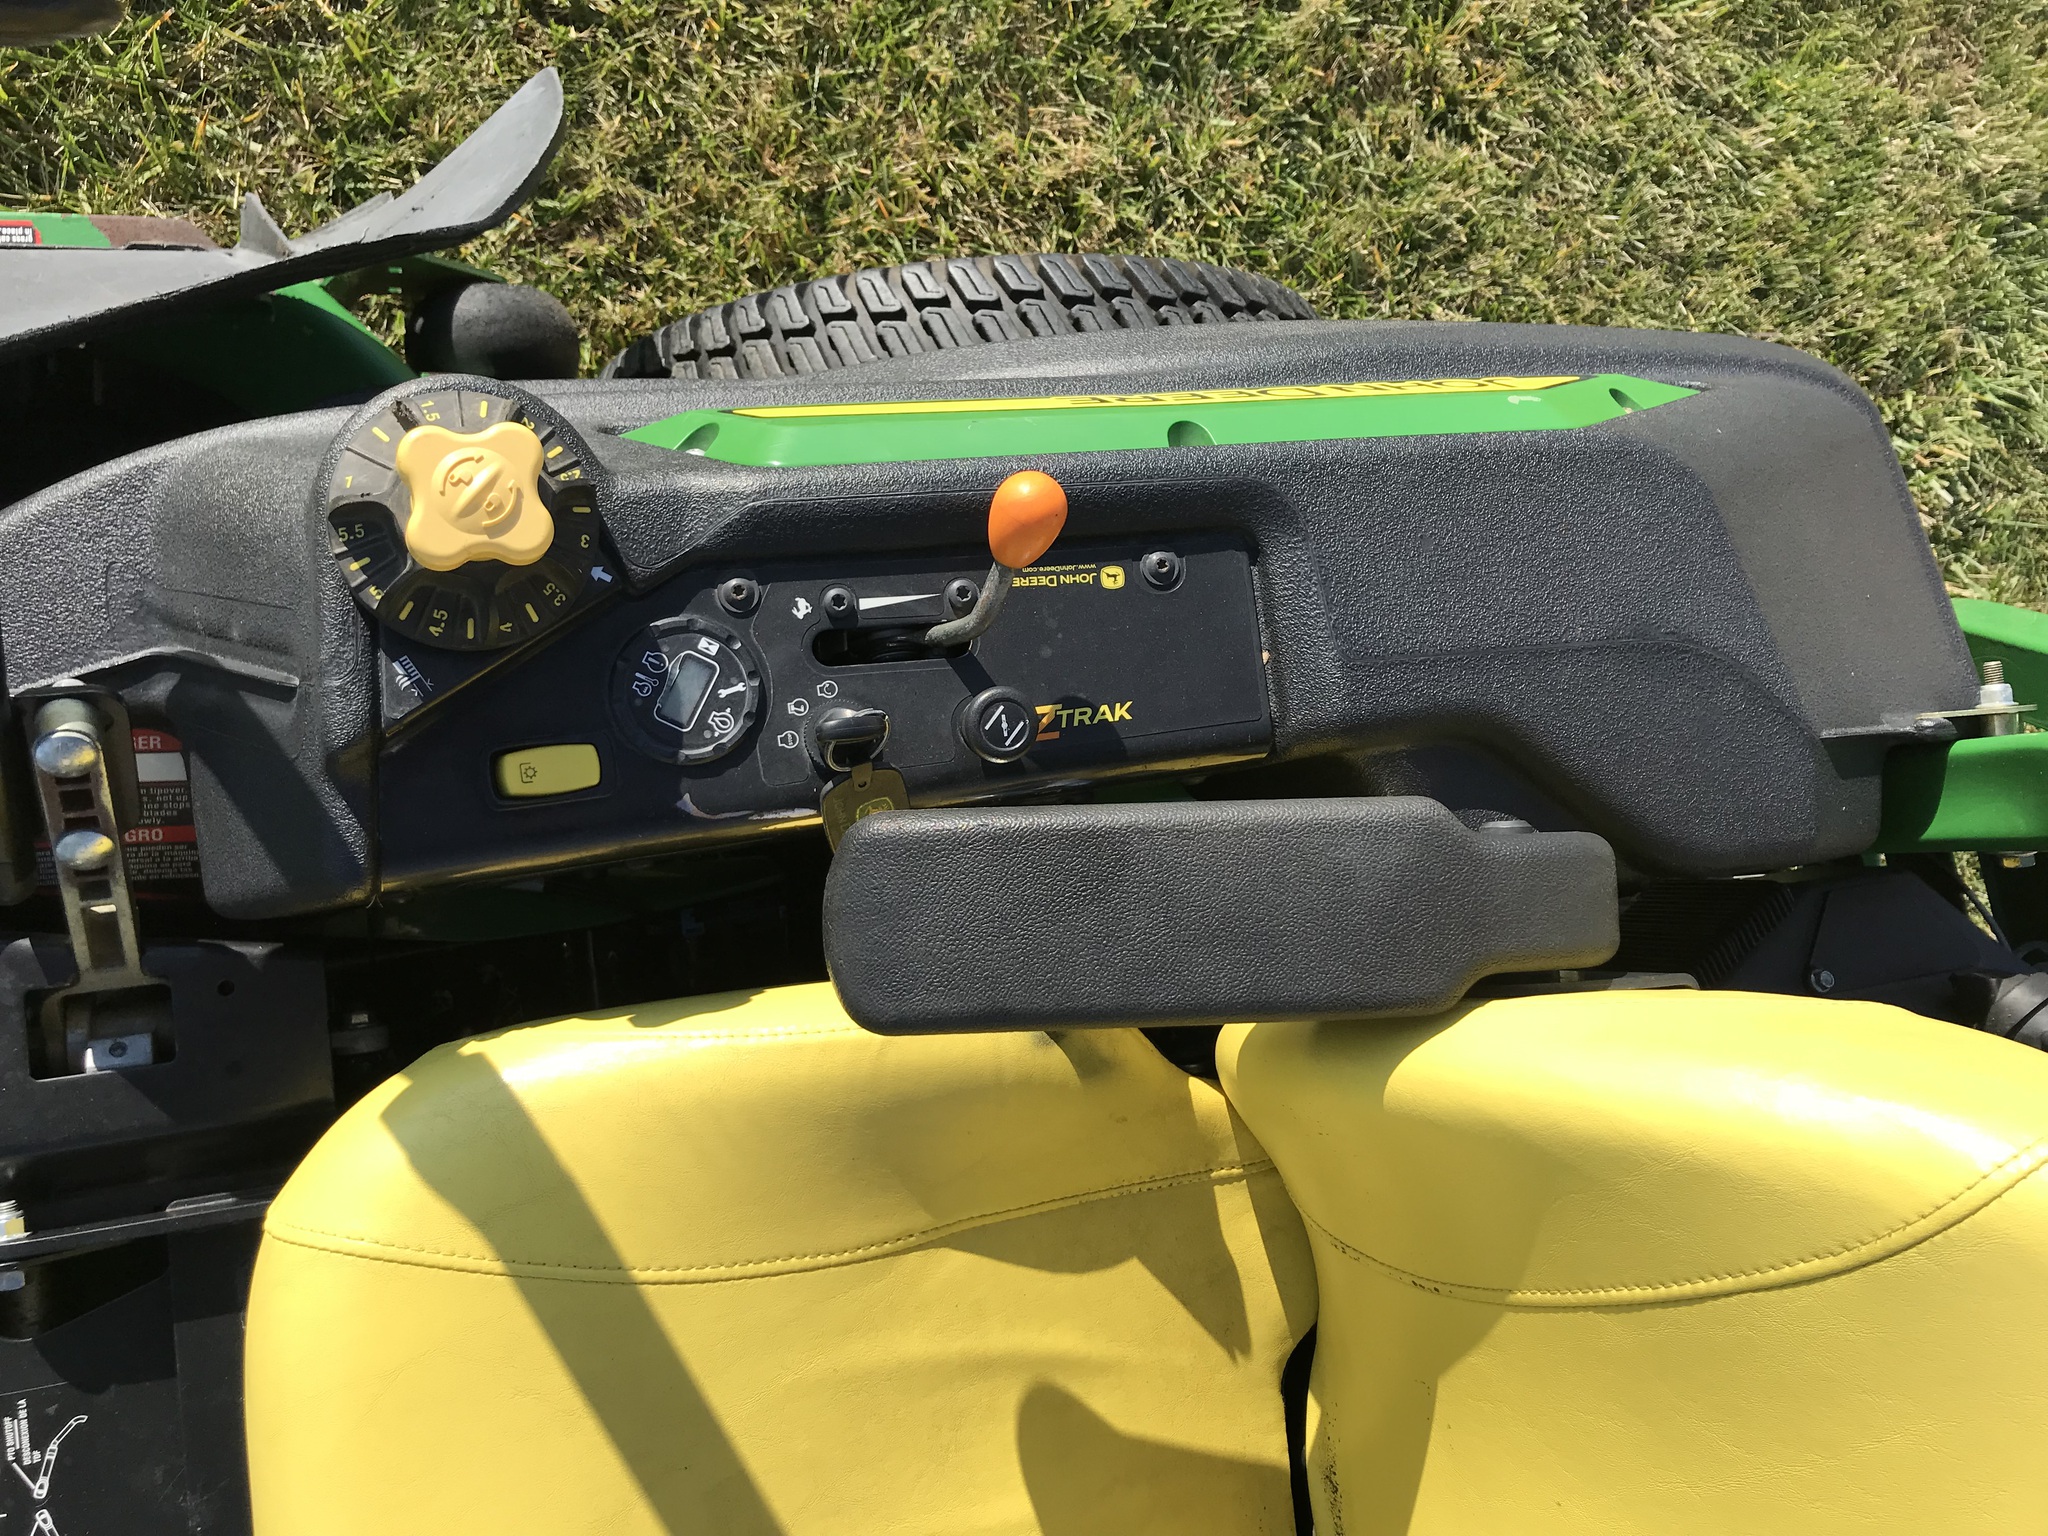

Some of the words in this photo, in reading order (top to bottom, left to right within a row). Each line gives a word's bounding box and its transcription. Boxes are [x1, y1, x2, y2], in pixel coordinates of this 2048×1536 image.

[1064, 386, 1328, 405] DEERE
[421, 400, 441, 422] 1.5
[521, 417, 535, 430] 2
[345, 475, 352, 488] 1
[338, 524, 365, 542] 5.5
[580, 535, 590, 549] 3
[1021, 563, 1097, 573] www.JohnDeere.com
[1012, 575, 1057, 587] DEERE
[1060, 573, 1098, 585] JOHN
[369, 585, 385, 600] 5
[543, 582, 567, 607] 3.5
[429, 608, 448, 637] 4.5
[500, 622, 513, 633] 4
[17, 1398, 27, 1409] LA
[18, 1409, 27, 1419] DE
[4, 1416, 15, 1446] SHUTOFF
[7, 1447, 16, 1461] PTO
